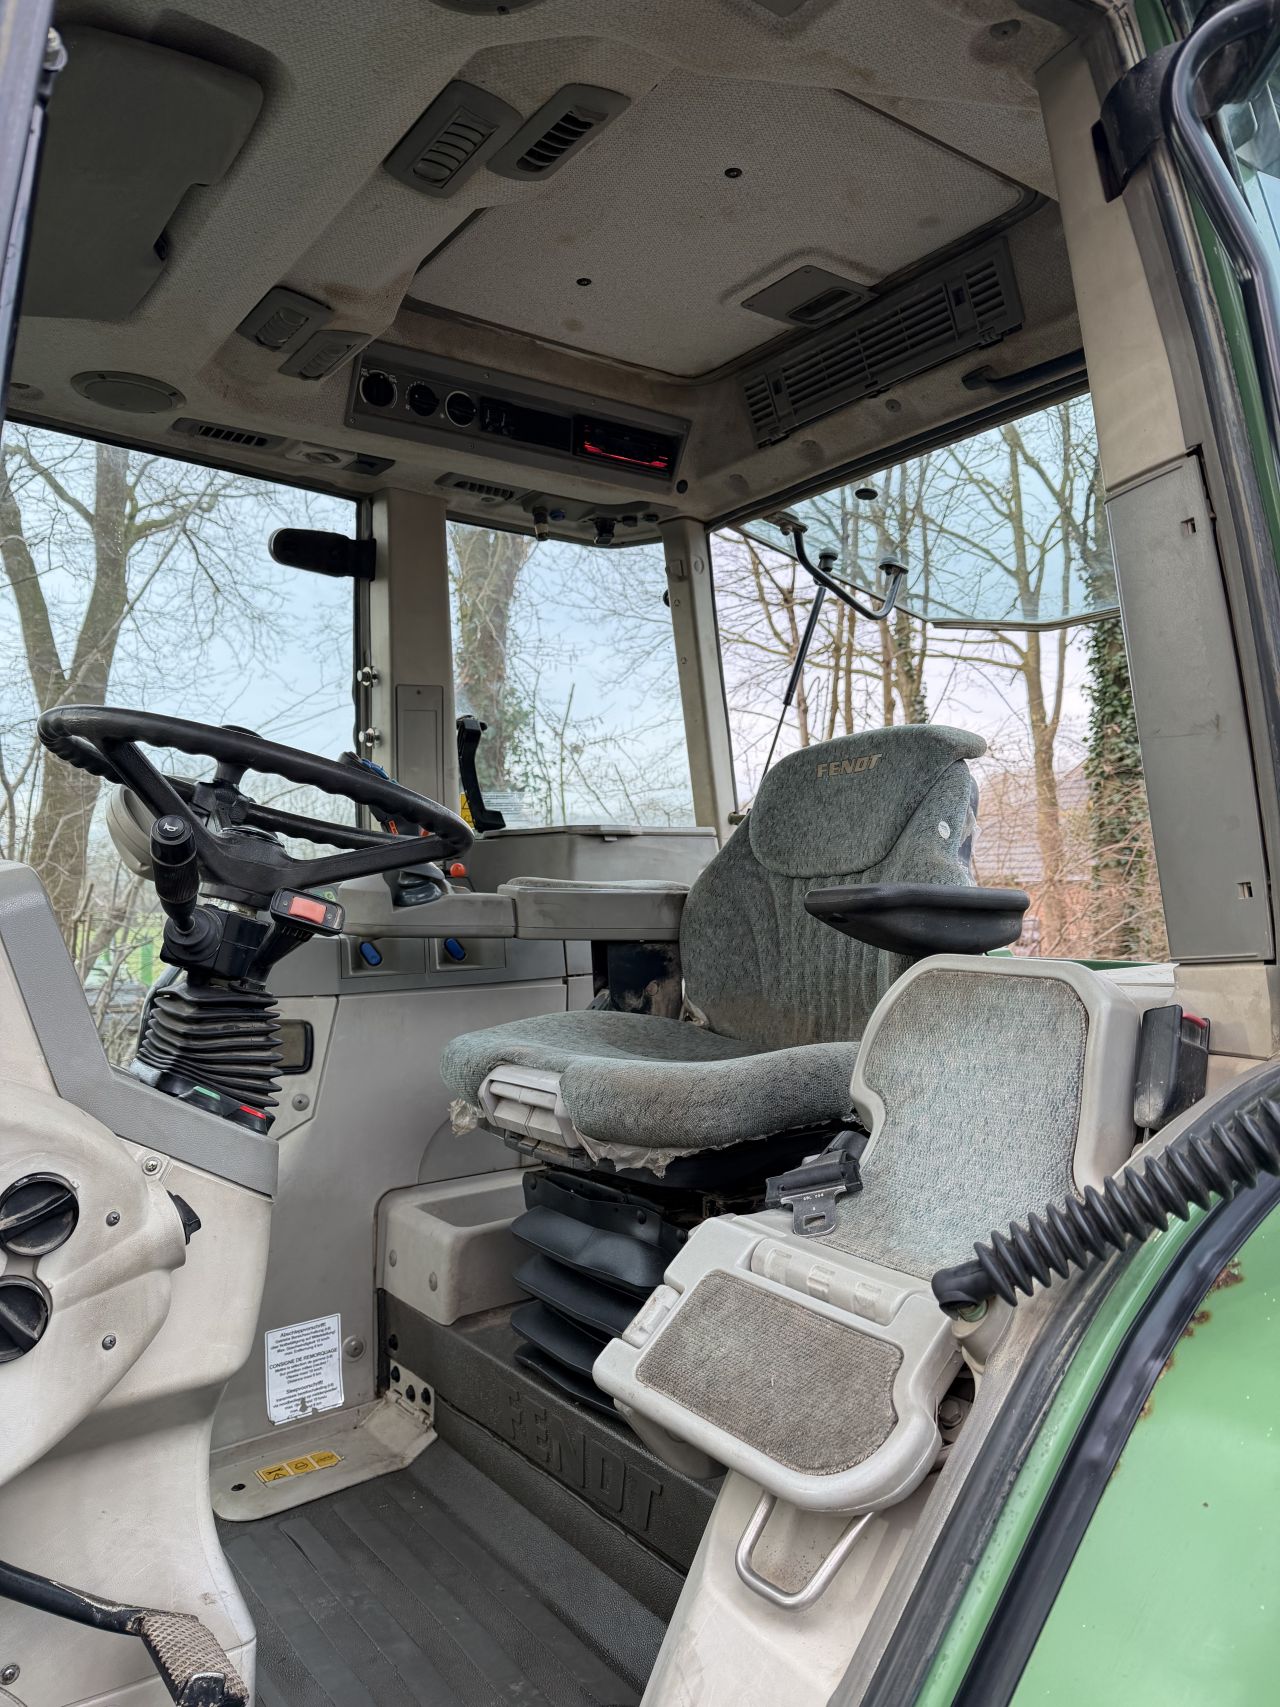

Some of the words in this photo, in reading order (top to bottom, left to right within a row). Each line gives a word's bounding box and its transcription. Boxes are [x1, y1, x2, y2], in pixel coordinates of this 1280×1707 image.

[817, 753, 882, 778] FENDT
[269, 1359, 294, 1370] CONSIGNE
[303, 1347, 336, 1360] REMORQUAGE
[499, 1380, 663, 1532] FENDT
